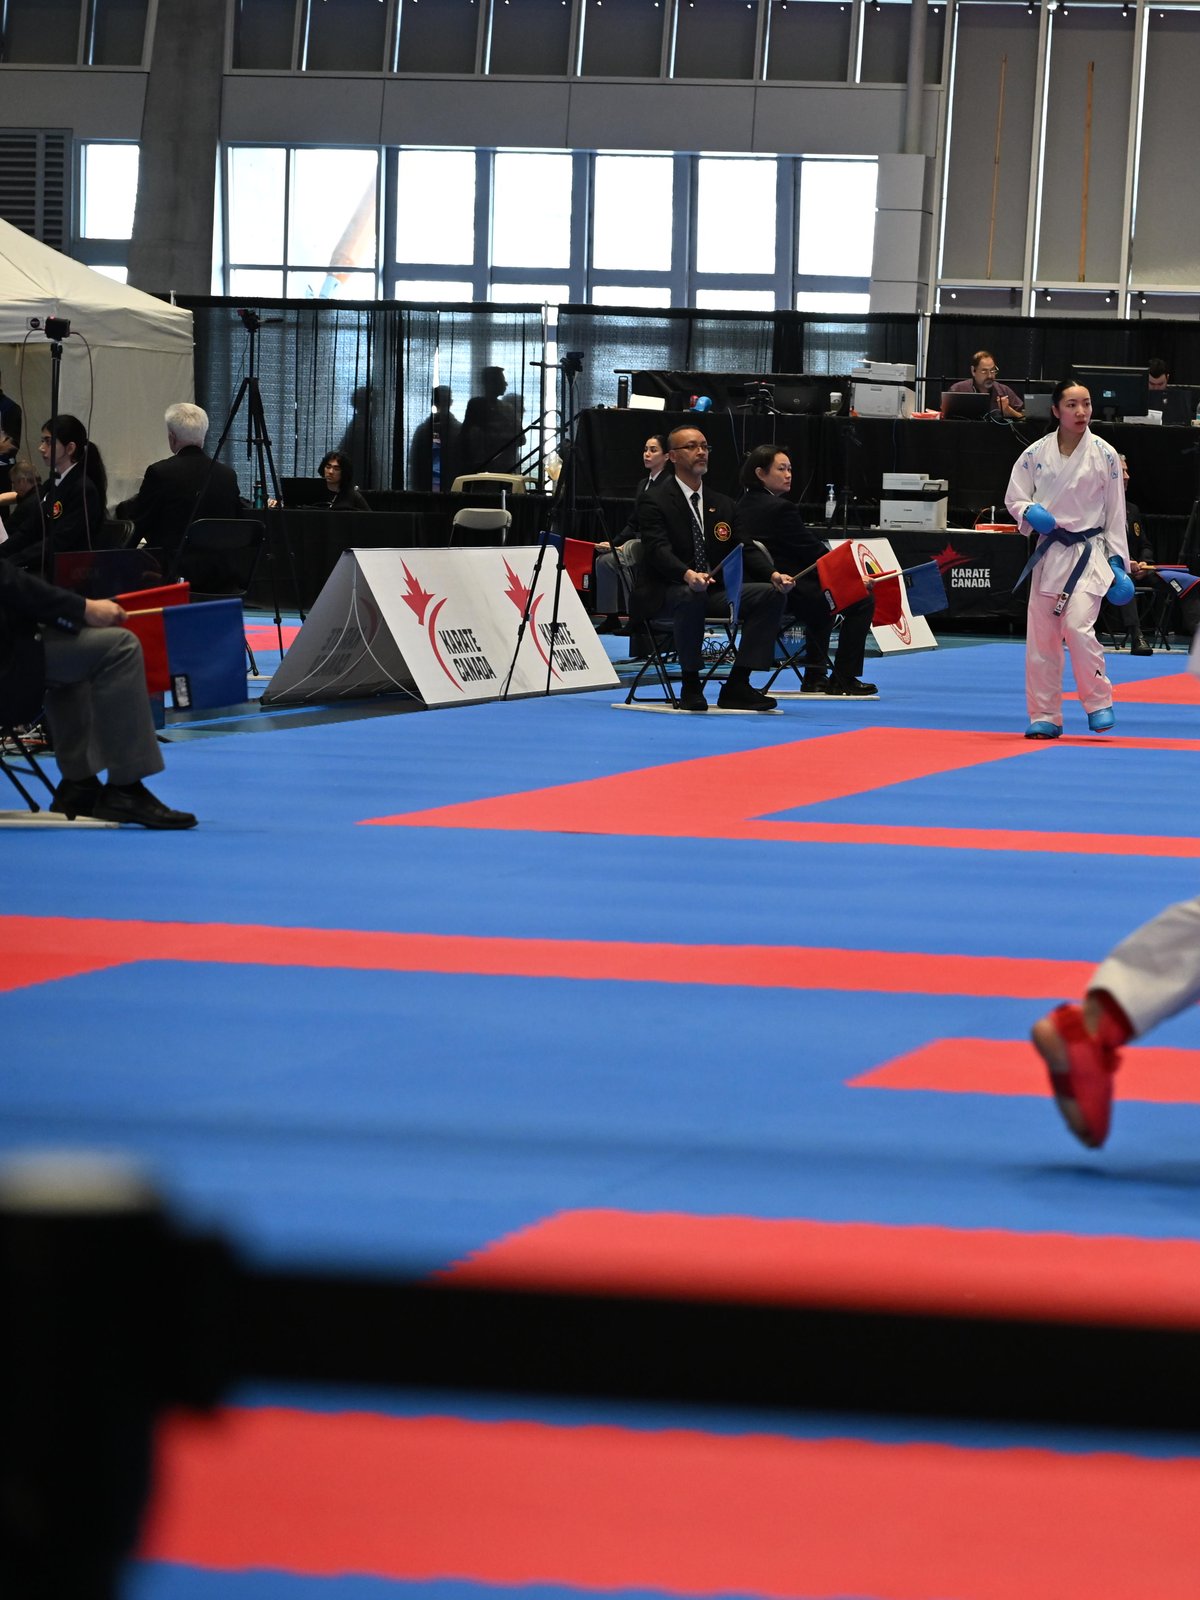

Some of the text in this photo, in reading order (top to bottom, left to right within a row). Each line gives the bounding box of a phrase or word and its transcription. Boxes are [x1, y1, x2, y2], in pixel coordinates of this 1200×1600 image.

[951, 568, 991, 578] KARATE
[951, 578, 991, 588] CANADA
[438, 628, 482, 654] KARATE
[452, 655, 498, 682] CANADA
[552, 647, 590, 672] CANADA
